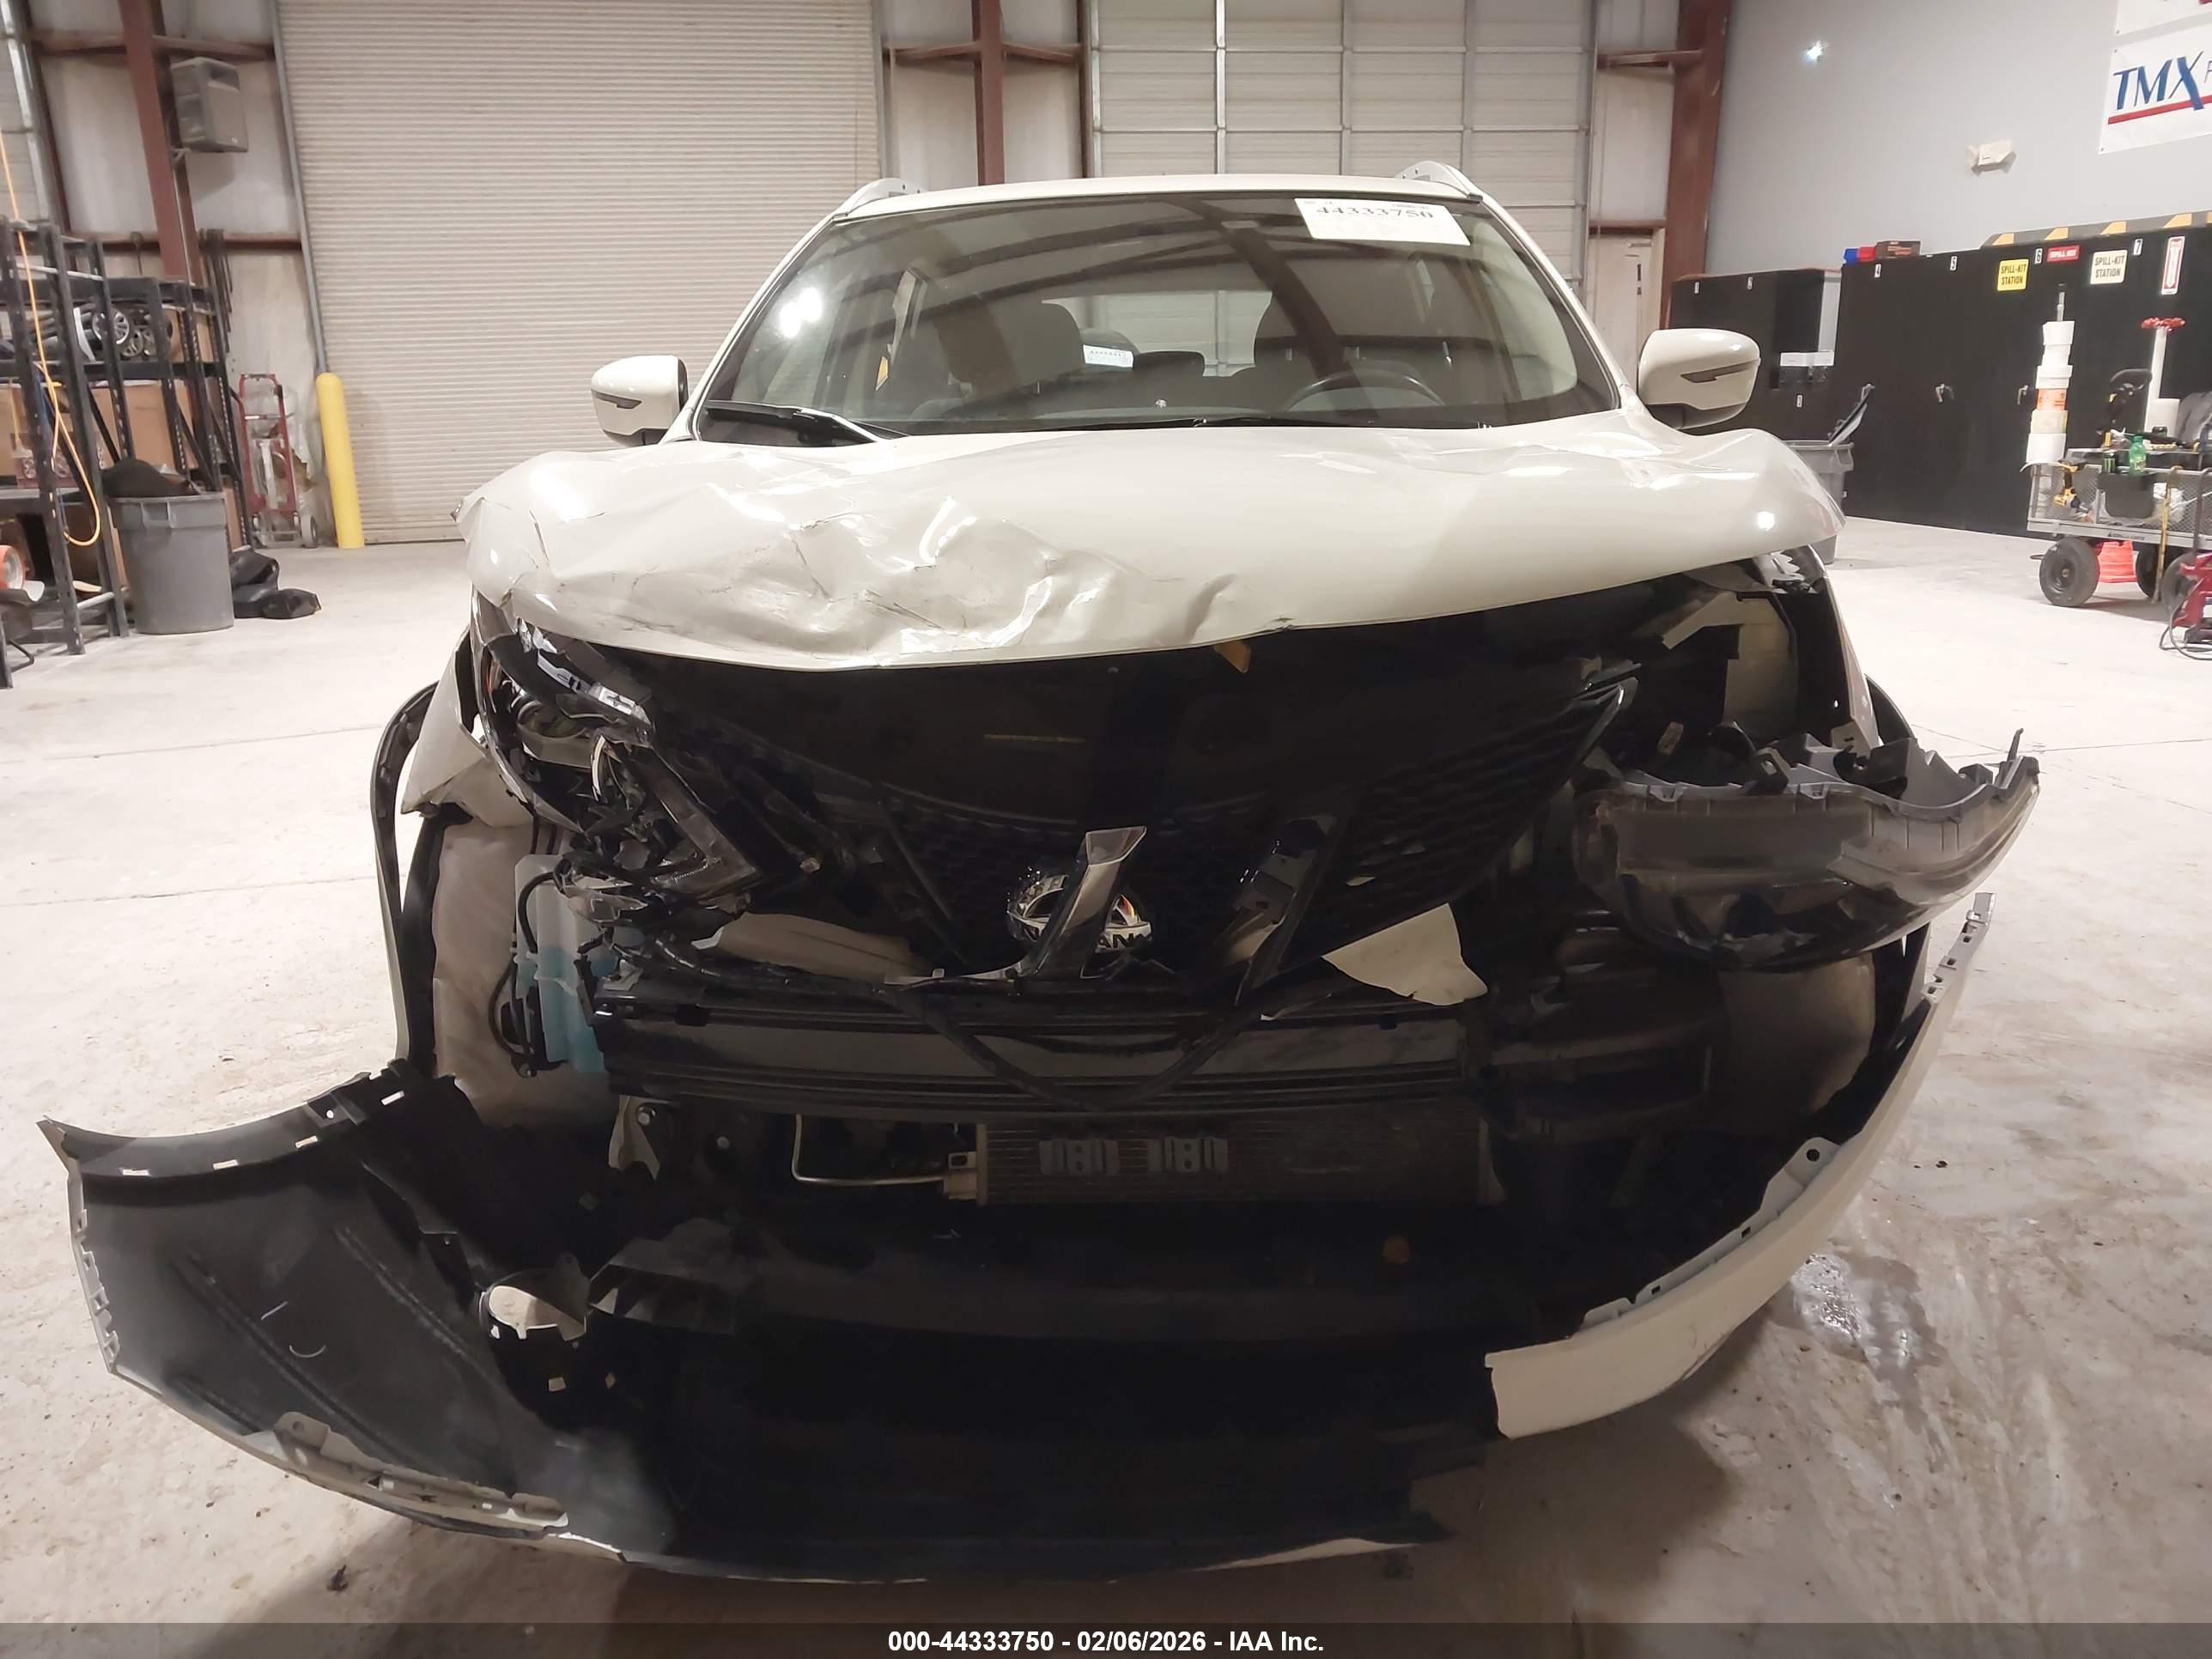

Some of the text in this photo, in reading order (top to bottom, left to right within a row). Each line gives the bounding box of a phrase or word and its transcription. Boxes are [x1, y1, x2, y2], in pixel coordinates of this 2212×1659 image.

[2113, 51, 2204, 111] TMX
[2094, 254, 2125, 265] SPILL-KIT
[2001, 264, 2027, 274] SPILL-KIT
[2095, 268, 2121, 278] STATION
[2002, 276, 2023, 285] STATION
